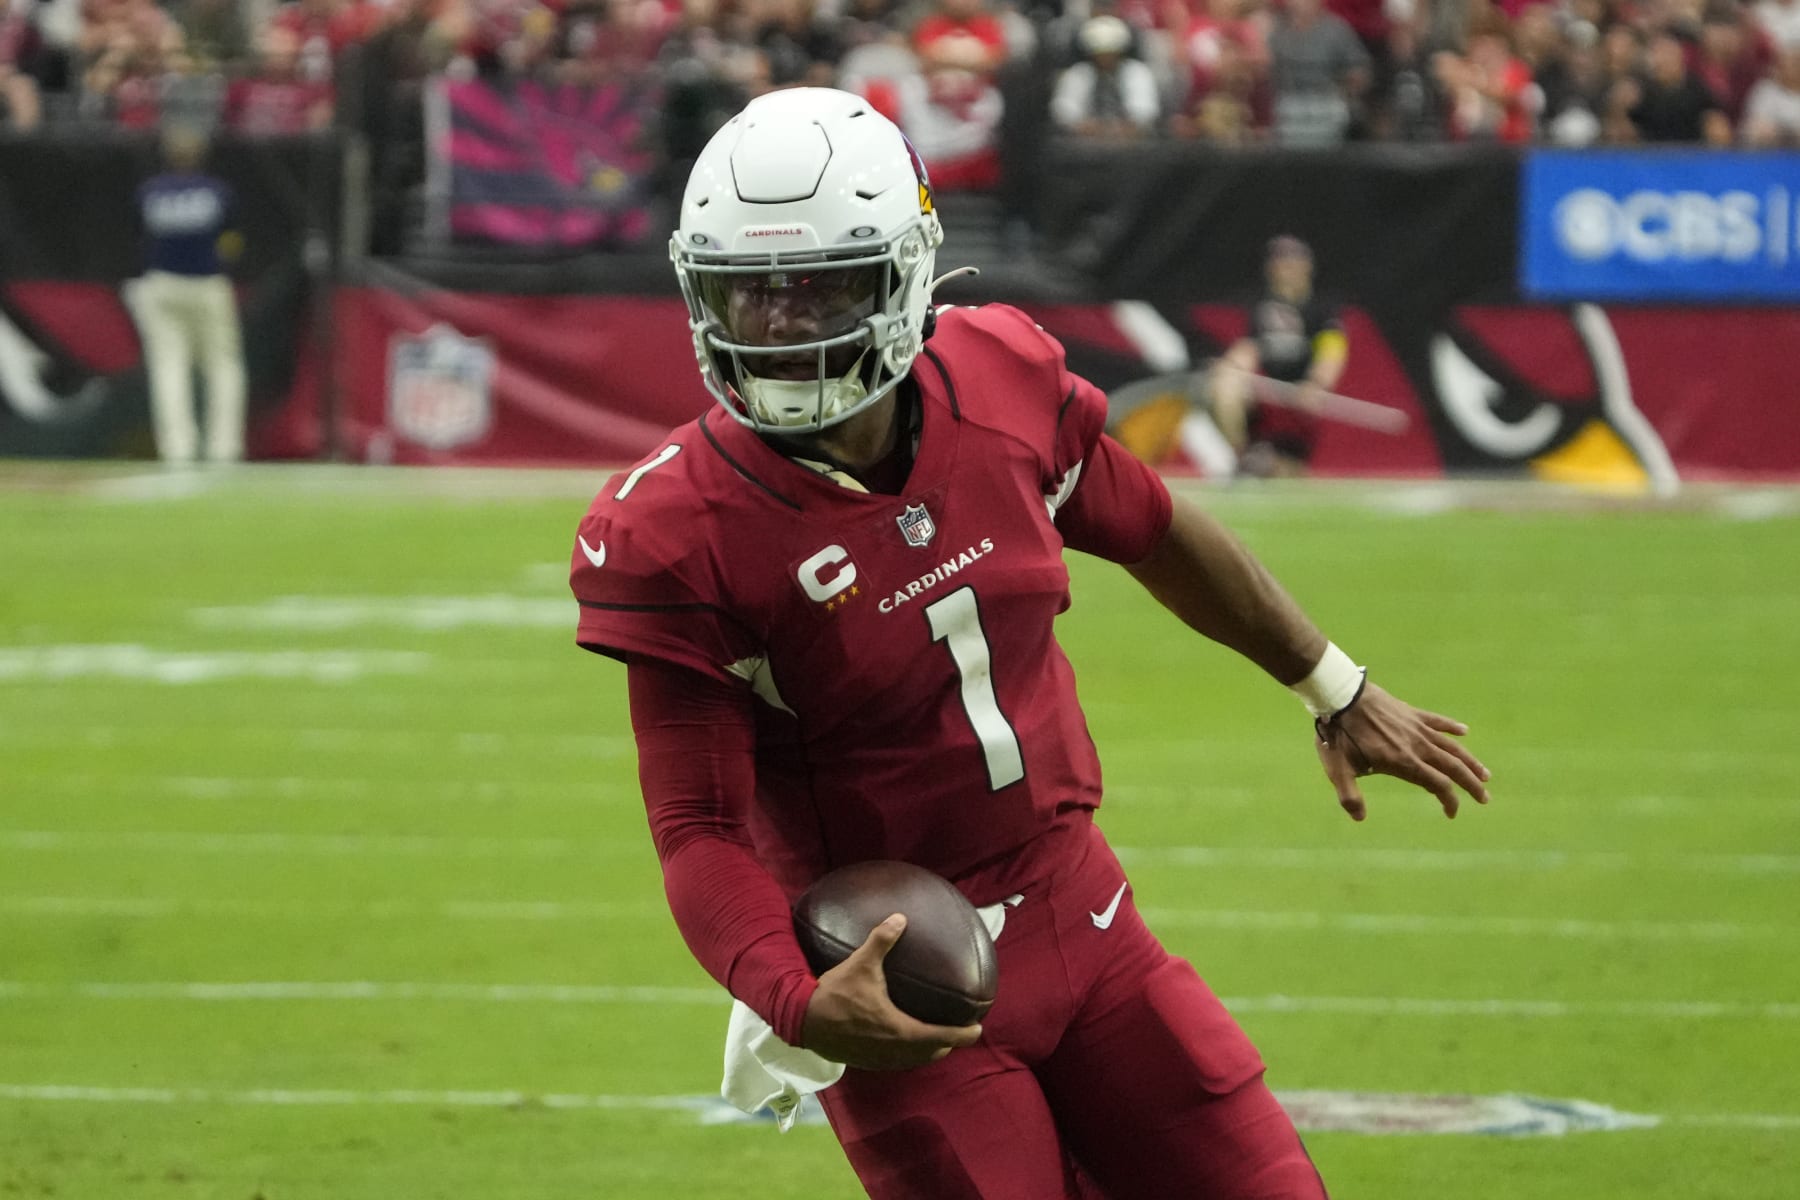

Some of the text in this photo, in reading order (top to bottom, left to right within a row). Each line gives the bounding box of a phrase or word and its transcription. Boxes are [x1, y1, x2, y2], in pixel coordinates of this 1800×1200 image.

[745, 228, 802, 237] CARDINALS
[1622, 190, 1761, 263] CBS
[613, 443, 683, 501] 1
[907, 520, 932, 541] NFL
[797, 544, 857, 603] C
[878, 537, 994, 614] CARDINALS
[925, 585, 1024, 791] 1
